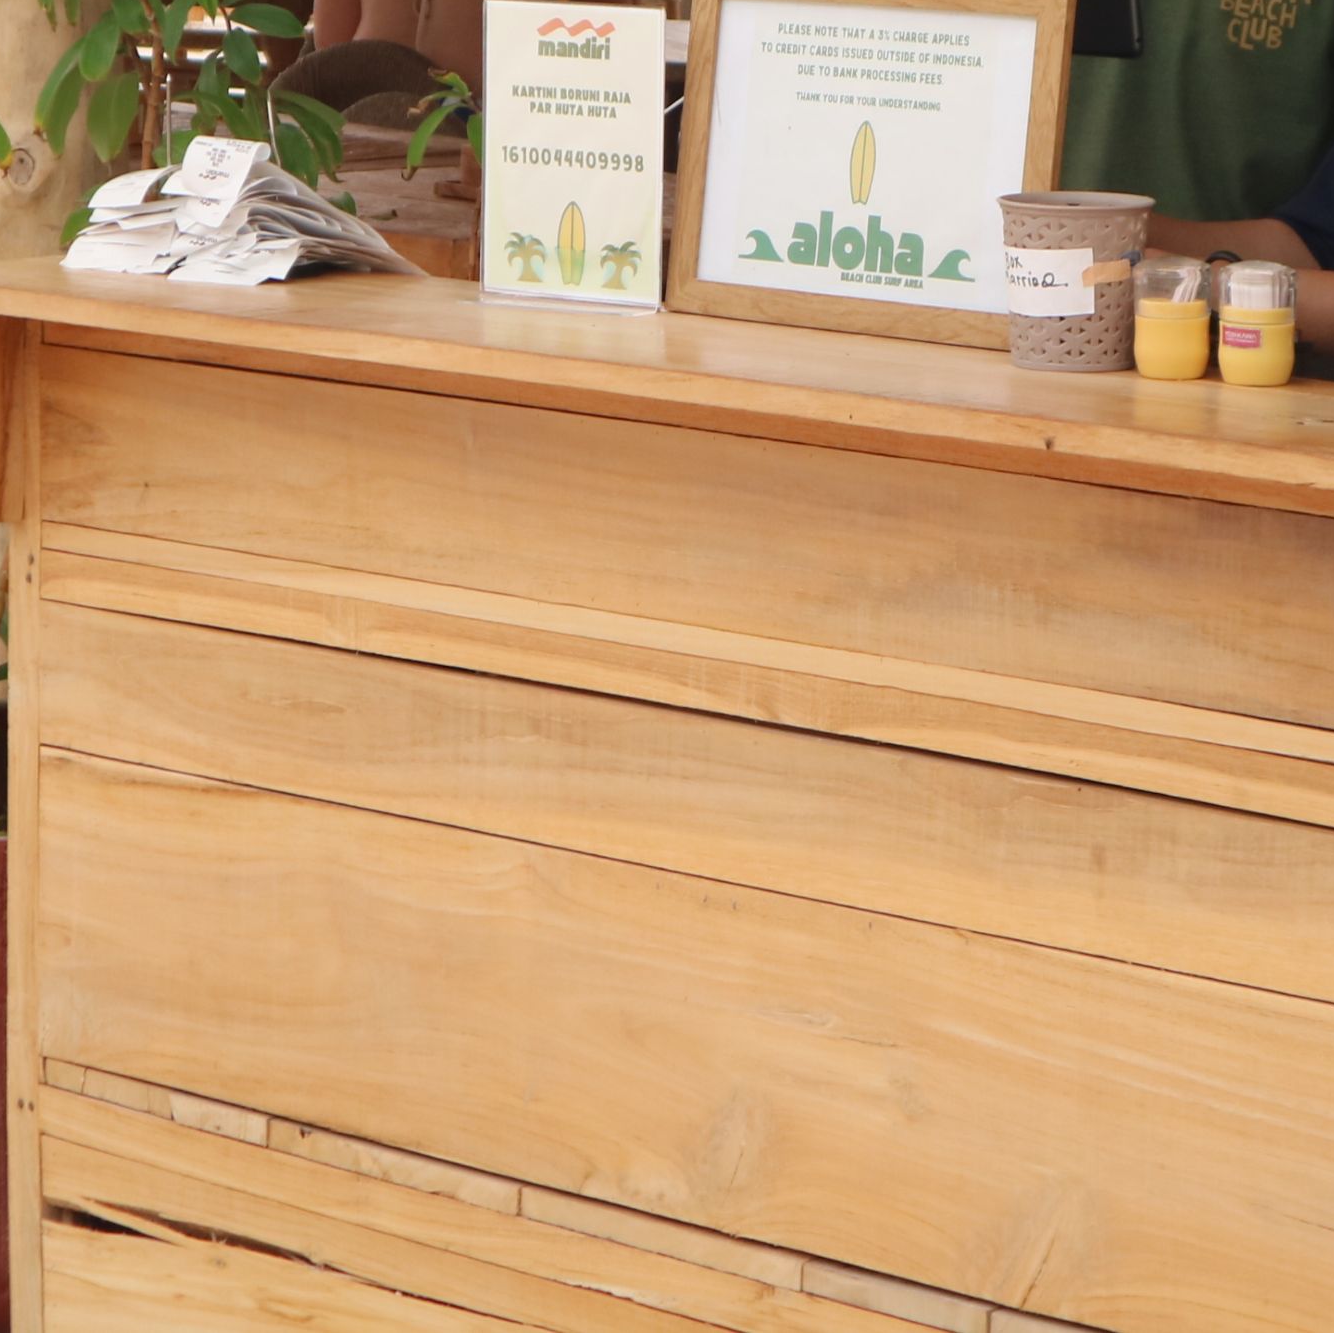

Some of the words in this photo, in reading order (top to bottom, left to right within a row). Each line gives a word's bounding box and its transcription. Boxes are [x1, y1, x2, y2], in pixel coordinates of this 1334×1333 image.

[778, 23, 811, 36] PLEASE
[814, 25, 838, 38] NOTE
[842, 27, 866, 39] THAT
[869, 29, 875, 40] A
[878, 29, 890, 41] 3%
[893, 31, 928, 44] CHARGE
[932, 33, 970, 47] APPLIES
[1227, 18, 1283, 50] CLUB
[538, 36, 611, 60] mandiri
[761, 41, 773, 53] TO
[775, 42, 807, 55] CREDIT
[809, 45, 839, 58] CARDS
[842, 47, 874, 60] ISSUED
[877, 49, 915, 63] OUTSIDE
[919, 52, 931, 64] OF
[797, 64, 815, 76] DUE
[818, 65, 831, 77] TO
[833, 66, 858, 78] BANK
[860, 68, 917, 83] PROCESSING
[512, 85, 557, 99] KARTINI
[560, 88, 600, 102] BORUNI
[603, 91, 631, 104] RAJA
[795, 91, 820, 102] THANK
[823, 93, 838, 103] YOU
[840, 94, 854, 105] FOR
[857, 96, 876, 106] YOUR
[530, 101, 552, 114] PAR
[555, 103, 584, 116] HUTA
[587, 105, 617, 118] HUTA
[501, 145, 644, 173] 1610044409998
[787, 210, 924, 277] aloha
[840, 272, 864, 283] BEACH
[865, 274, 883, 285] CLUB
[884, 276, 902, 287] SURF
[903, 278, 924, 289] AREA
